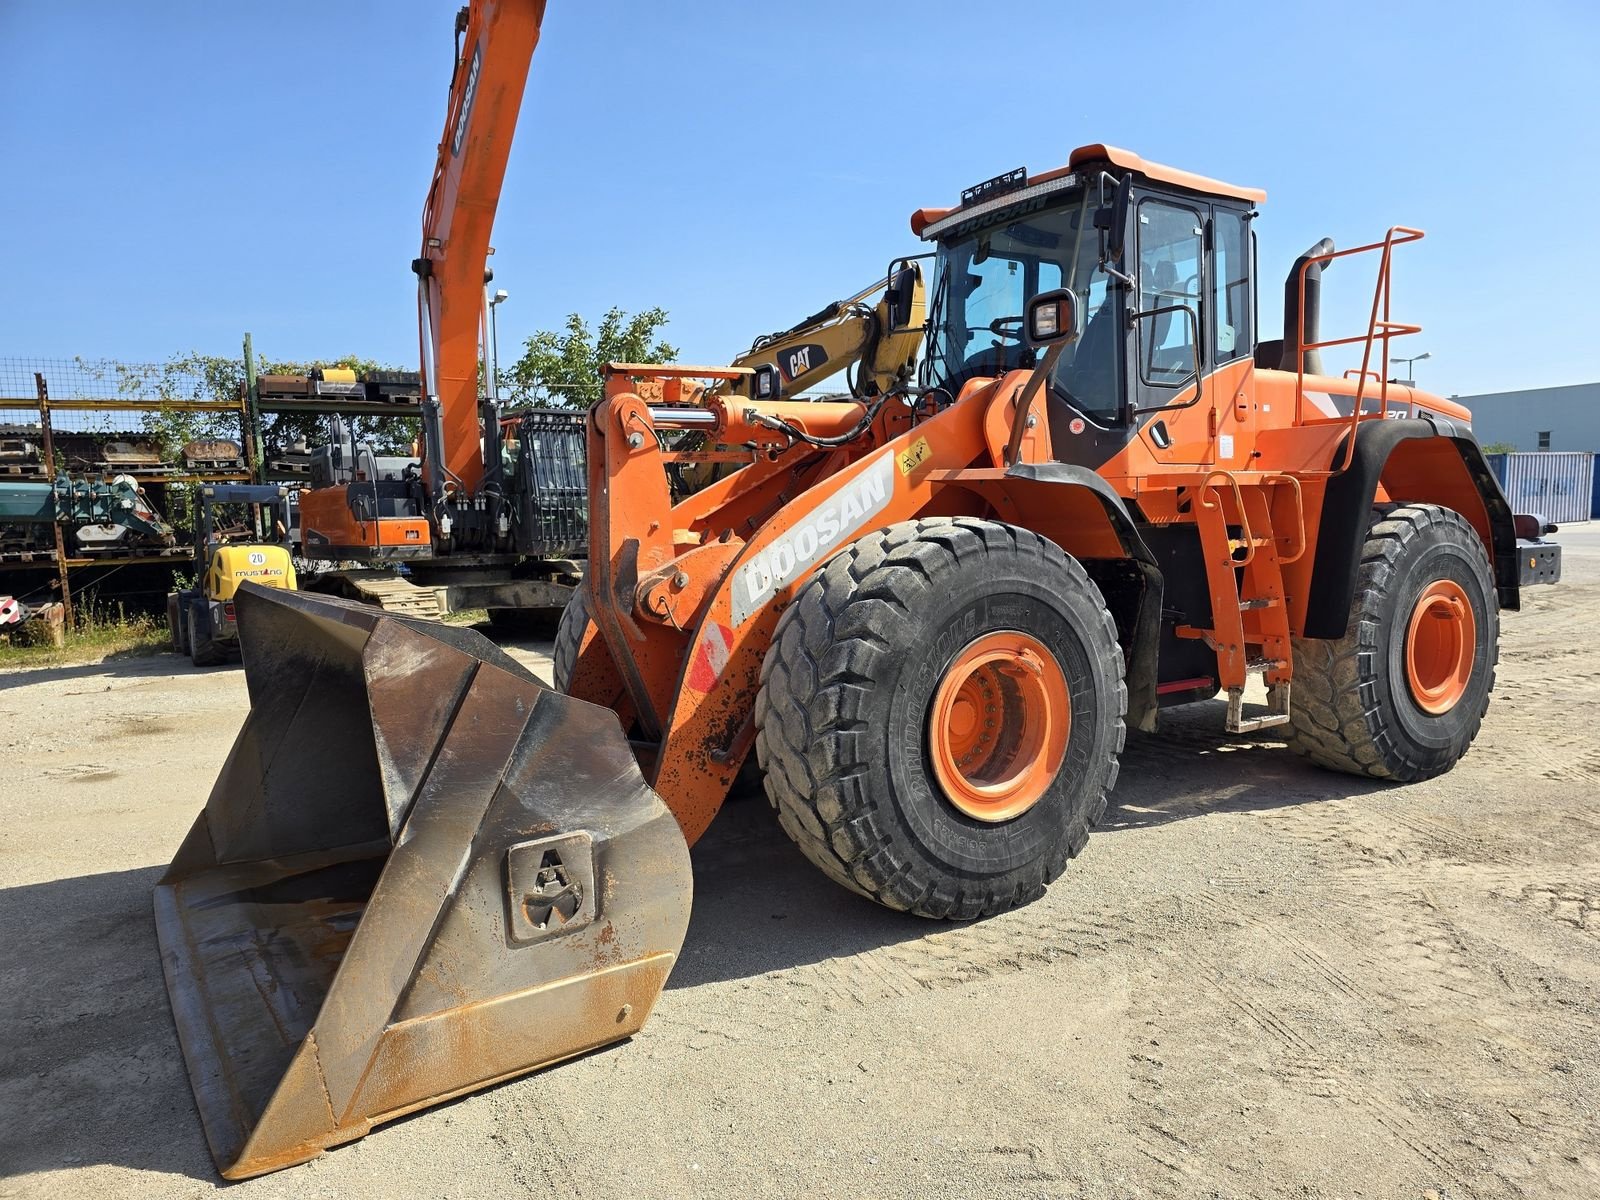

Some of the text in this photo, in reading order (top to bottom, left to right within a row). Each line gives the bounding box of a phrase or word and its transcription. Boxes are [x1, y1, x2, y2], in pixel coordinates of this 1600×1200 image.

[454, 51, 480, 153] DOOSAN
[790, 346, 810, 377] CAT
[251, 553, 263, 563] 20
[745, 473, 886, 603] DOOSAN
